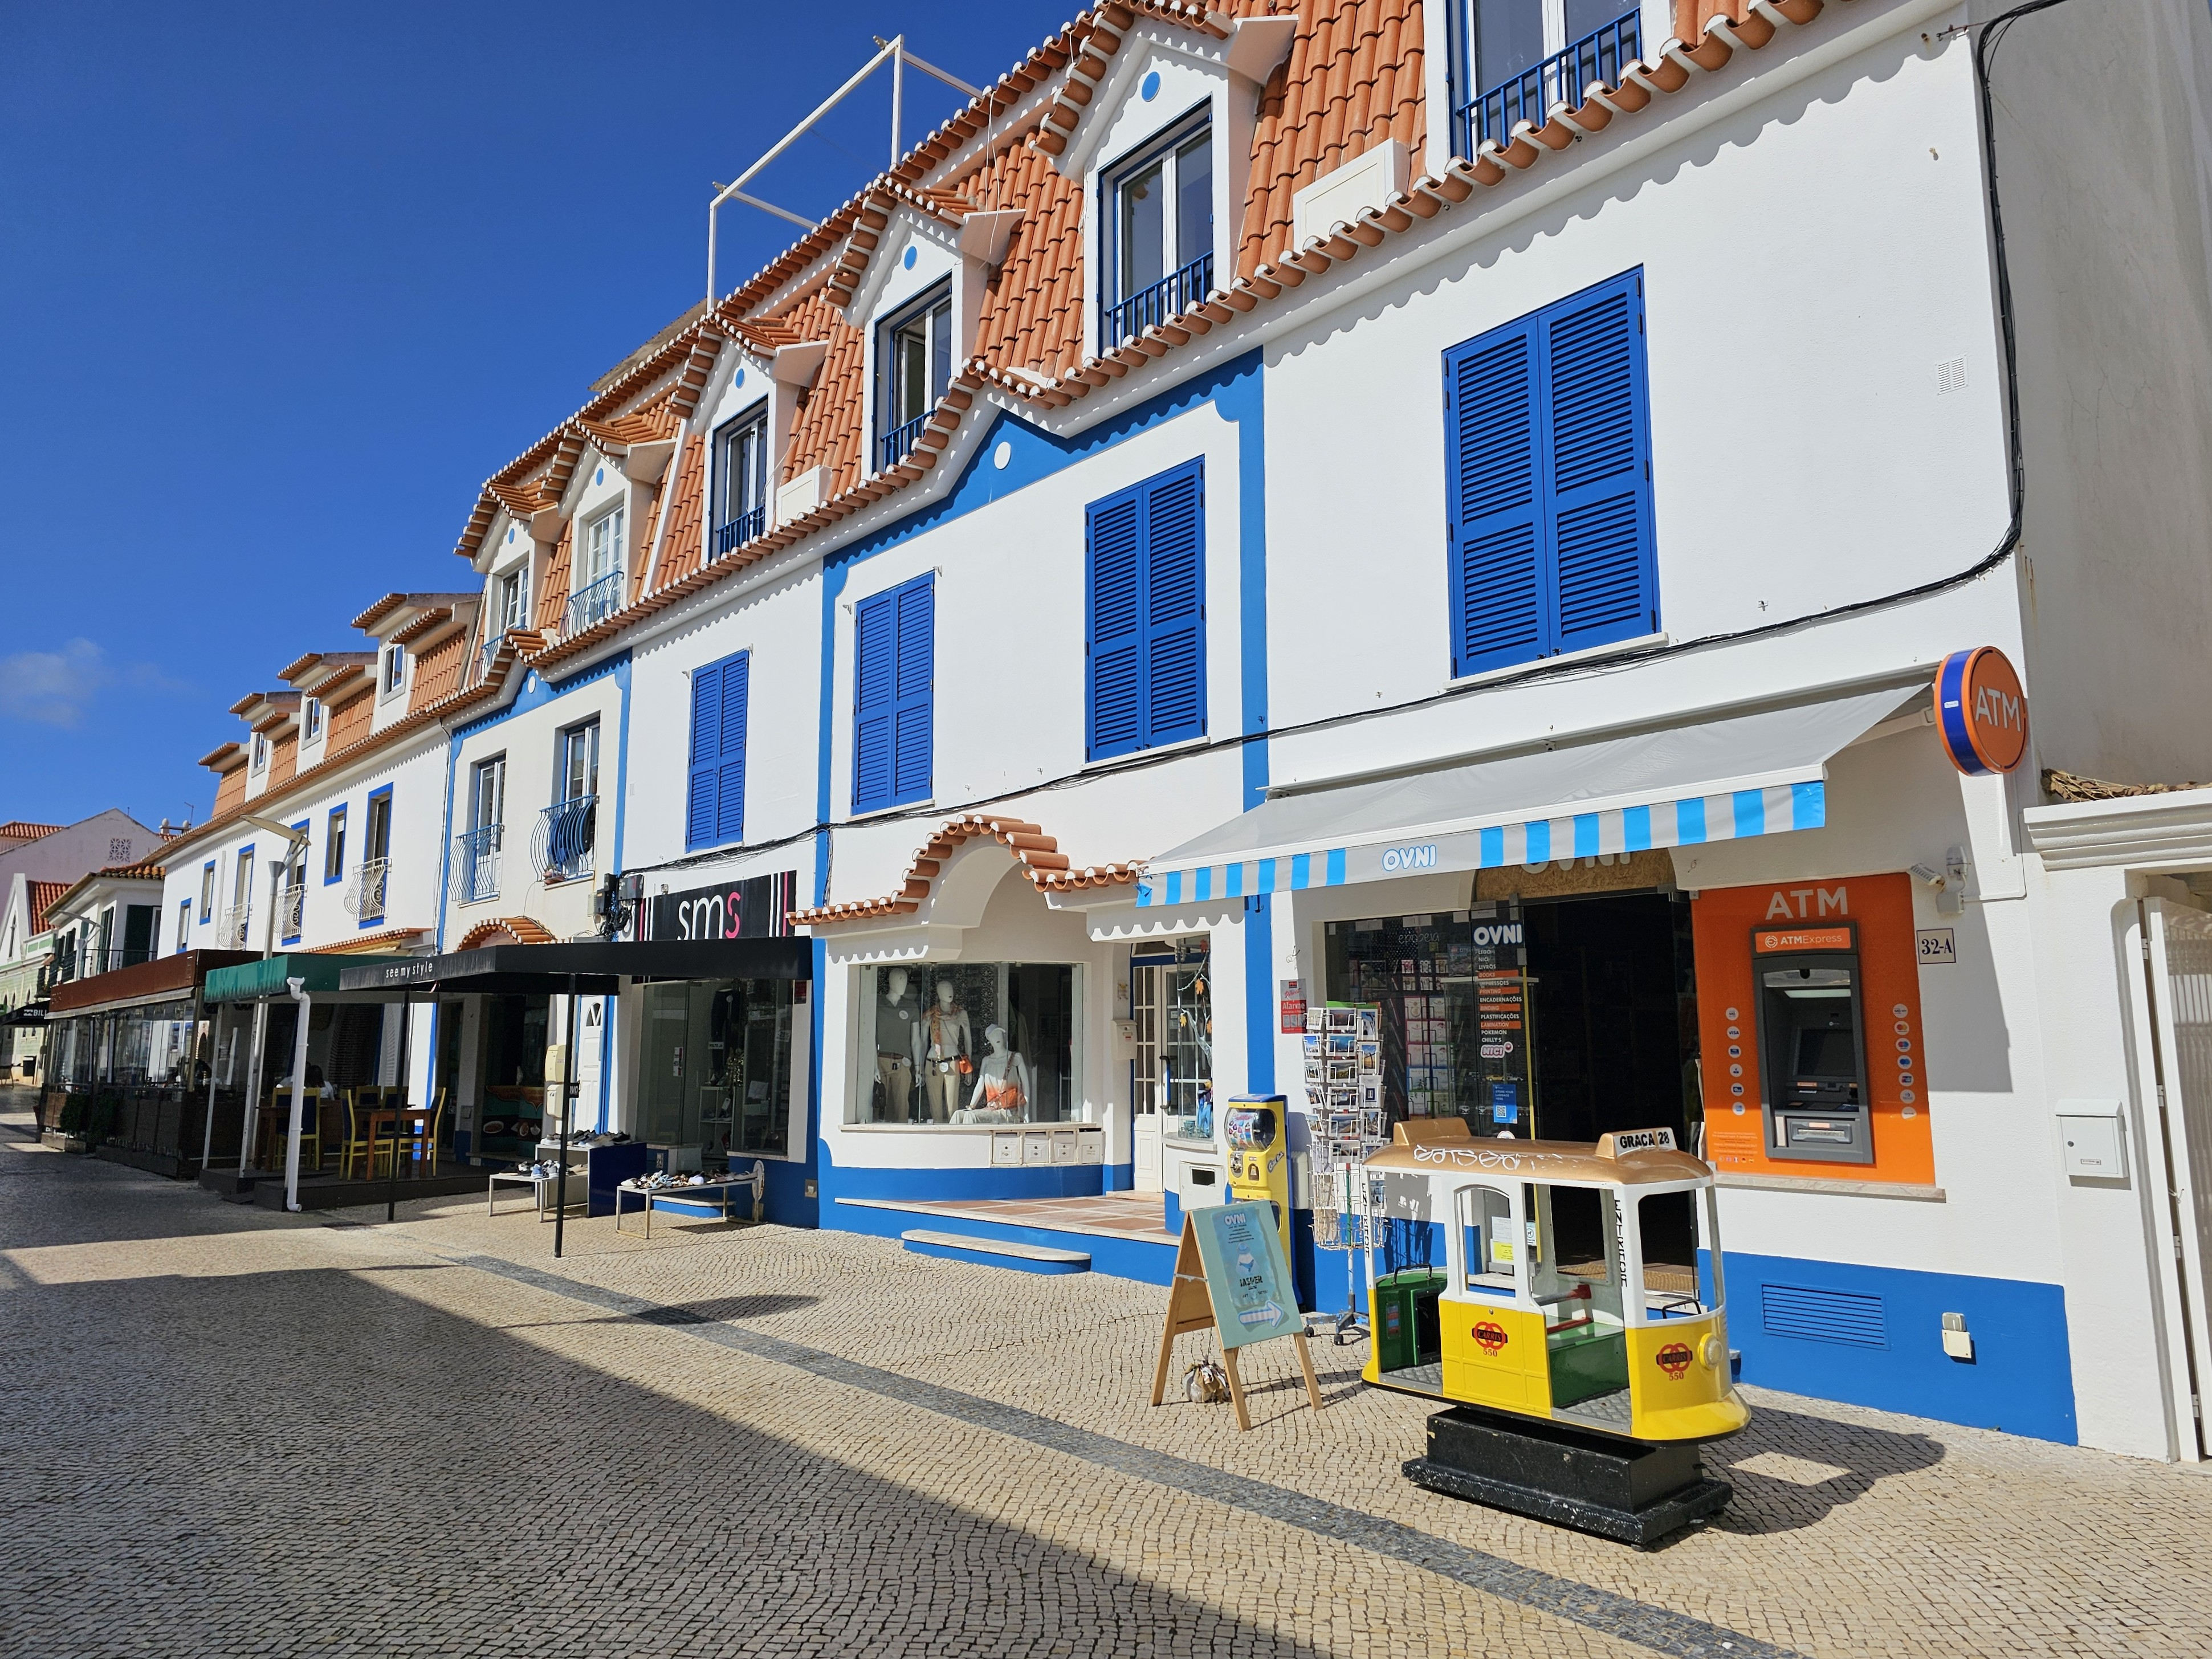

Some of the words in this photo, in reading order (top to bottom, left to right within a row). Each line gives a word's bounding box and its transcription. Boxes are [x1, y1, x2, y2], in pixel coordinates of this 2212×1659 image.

[1975, 686, 2020, 732] ATM
[1382, 845, 1436, 871] OVNI
[1765, 887, 1848, 920] ATM
[677, 892, 741, 940] sms
[1473, 924, 1522, 945] OVNI
[1780, 935, 1842, 945] ATMExpress
[1921, 937, 1952, 955] 32-A
[386, 968, 398, 979] see
[400, 967, 410, 979] my
[412, 961, 433, 976] style
[1482, 1046, 1504, 1056] NICI
[1658, 1131, 1669, 1144] 28
[1224, 1213, 1246, 1225] OVNI
[1615, 1200, 1627, 1287] ENTRADA
[1478, 1330, 1501, 1341] CARRIS
[1483, 1348, 1497, 1357] 550
[1669, 1372, 1684, 1381] 550
